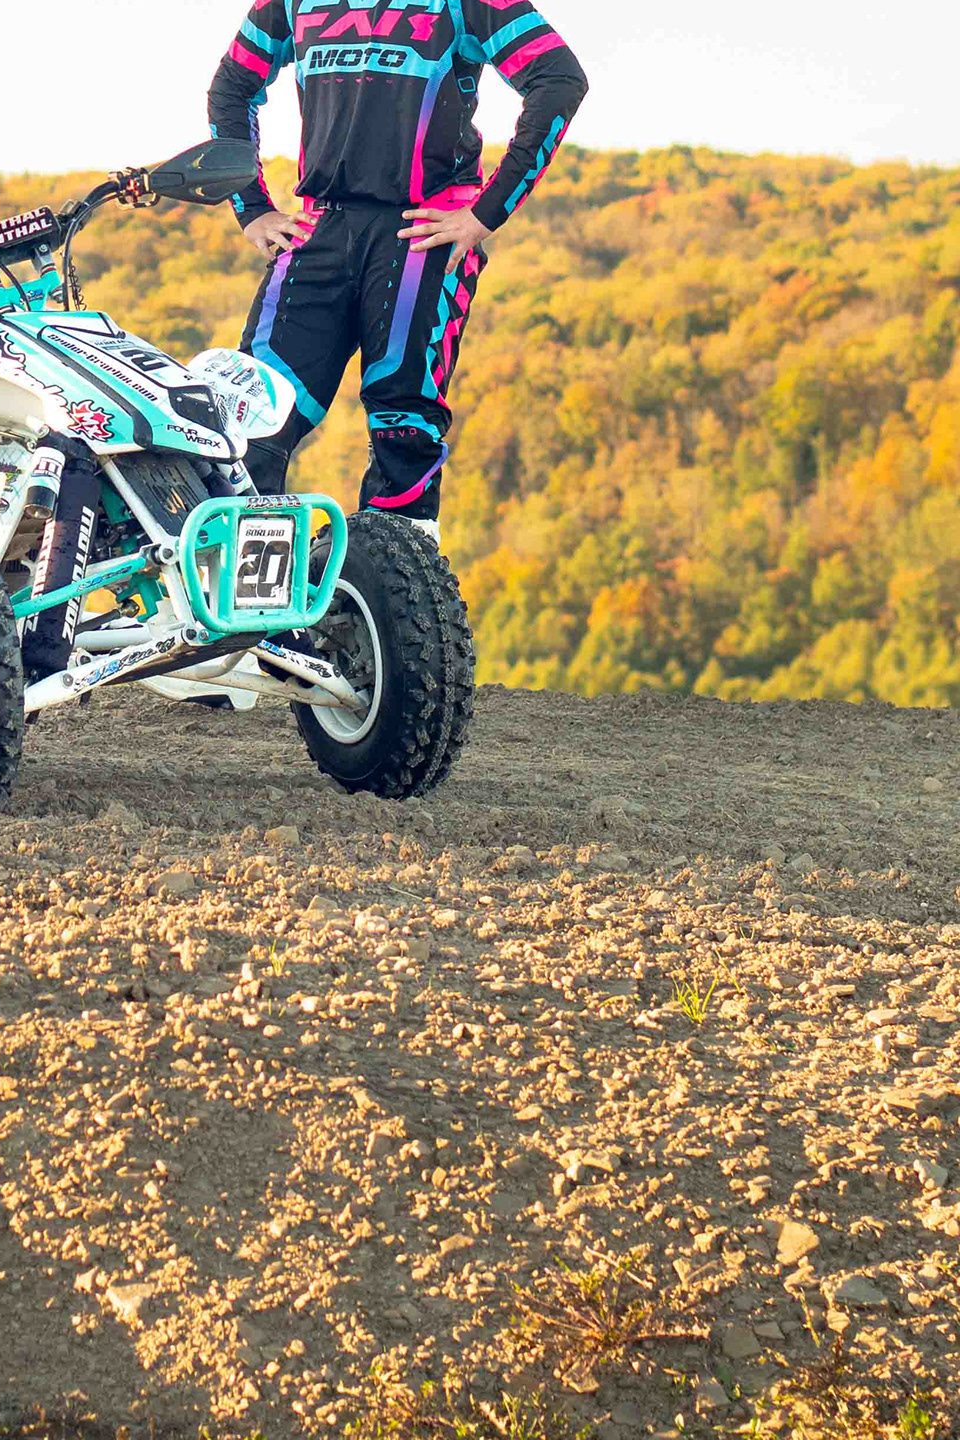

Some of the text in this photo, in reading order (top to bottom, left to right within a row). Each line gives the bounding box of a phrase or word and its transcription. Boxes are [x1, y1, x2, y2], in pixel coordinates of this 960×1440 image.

[309, 47, 407, 69] MOTO
[166, 424, 198, 437] FOUR
[376, 427, 418, 439] REVO
[185, 433, 221, 449] WERX
[236, 540, 290, 597] 20
